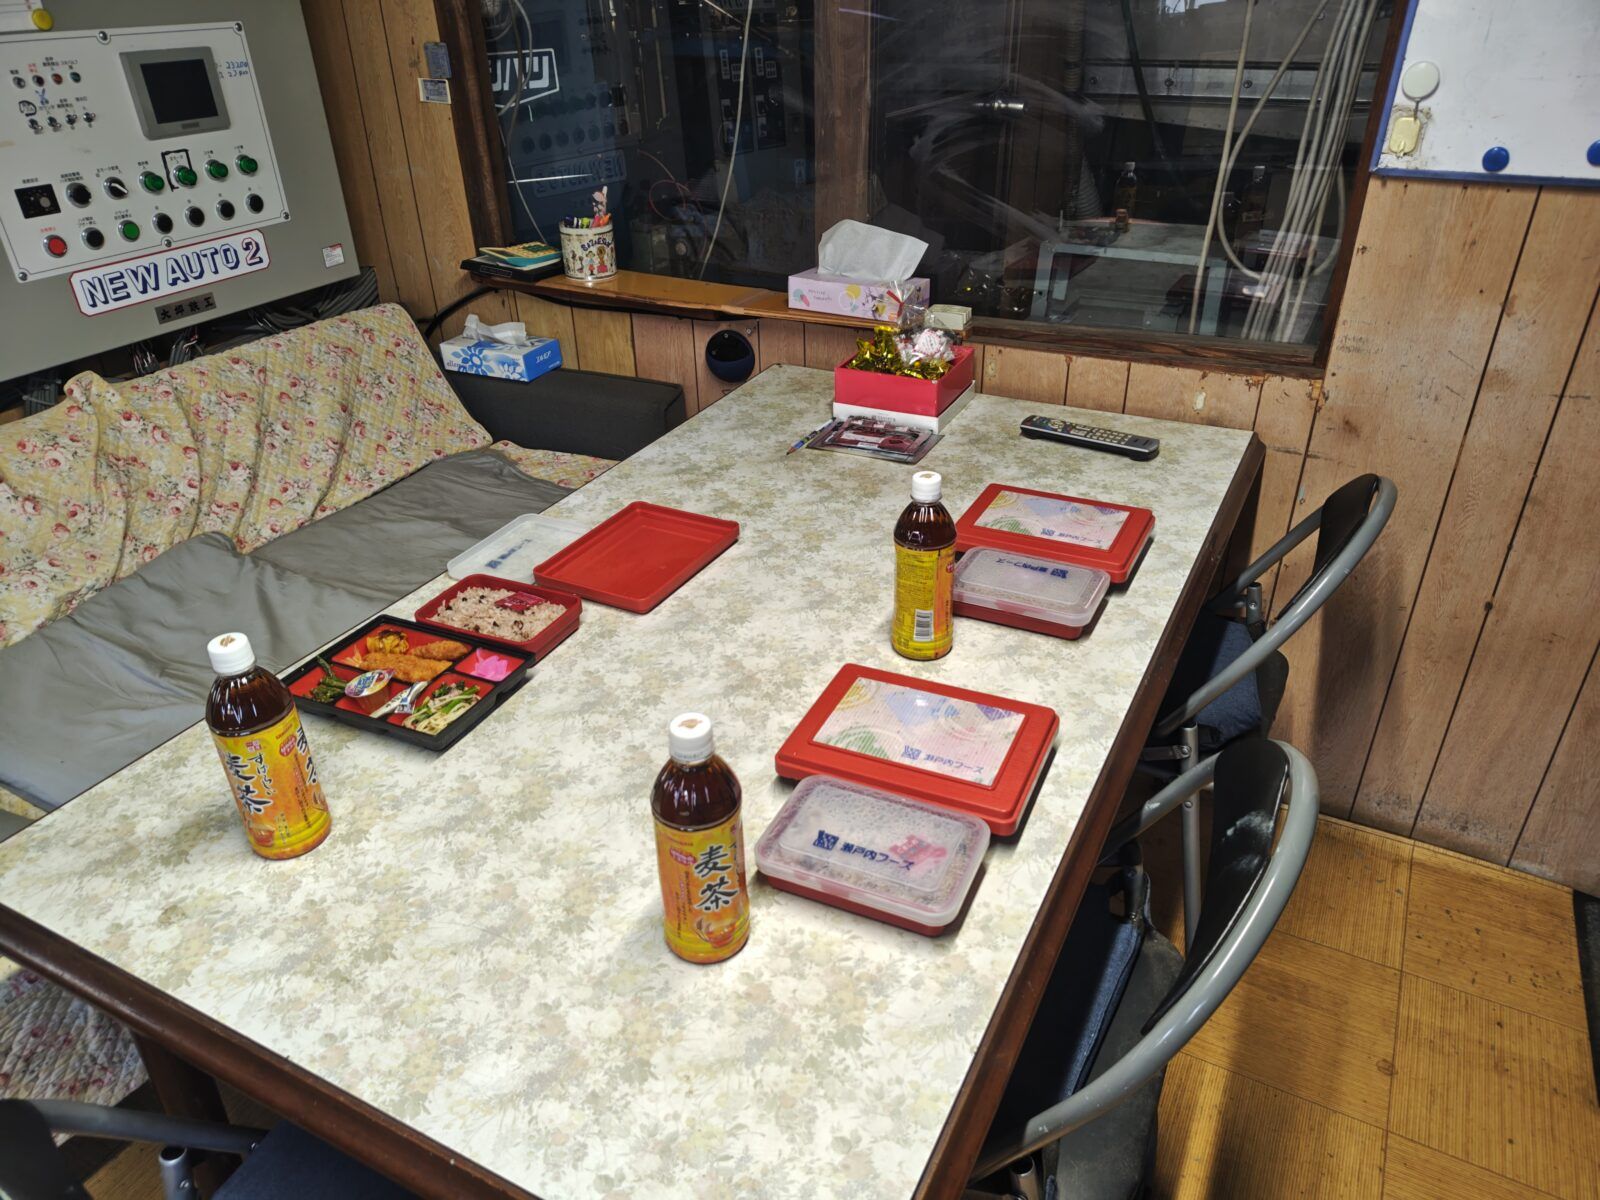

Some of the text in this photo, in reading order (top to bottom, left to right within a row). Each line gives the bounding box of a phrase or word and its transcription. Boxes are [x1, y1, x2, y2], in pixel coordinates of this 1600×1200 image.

[80, 237, 264, 309] NEW AUTO 2
[226, 752, 272, 815] 麦茶
[694, 845, 739, 911] 麦茶
